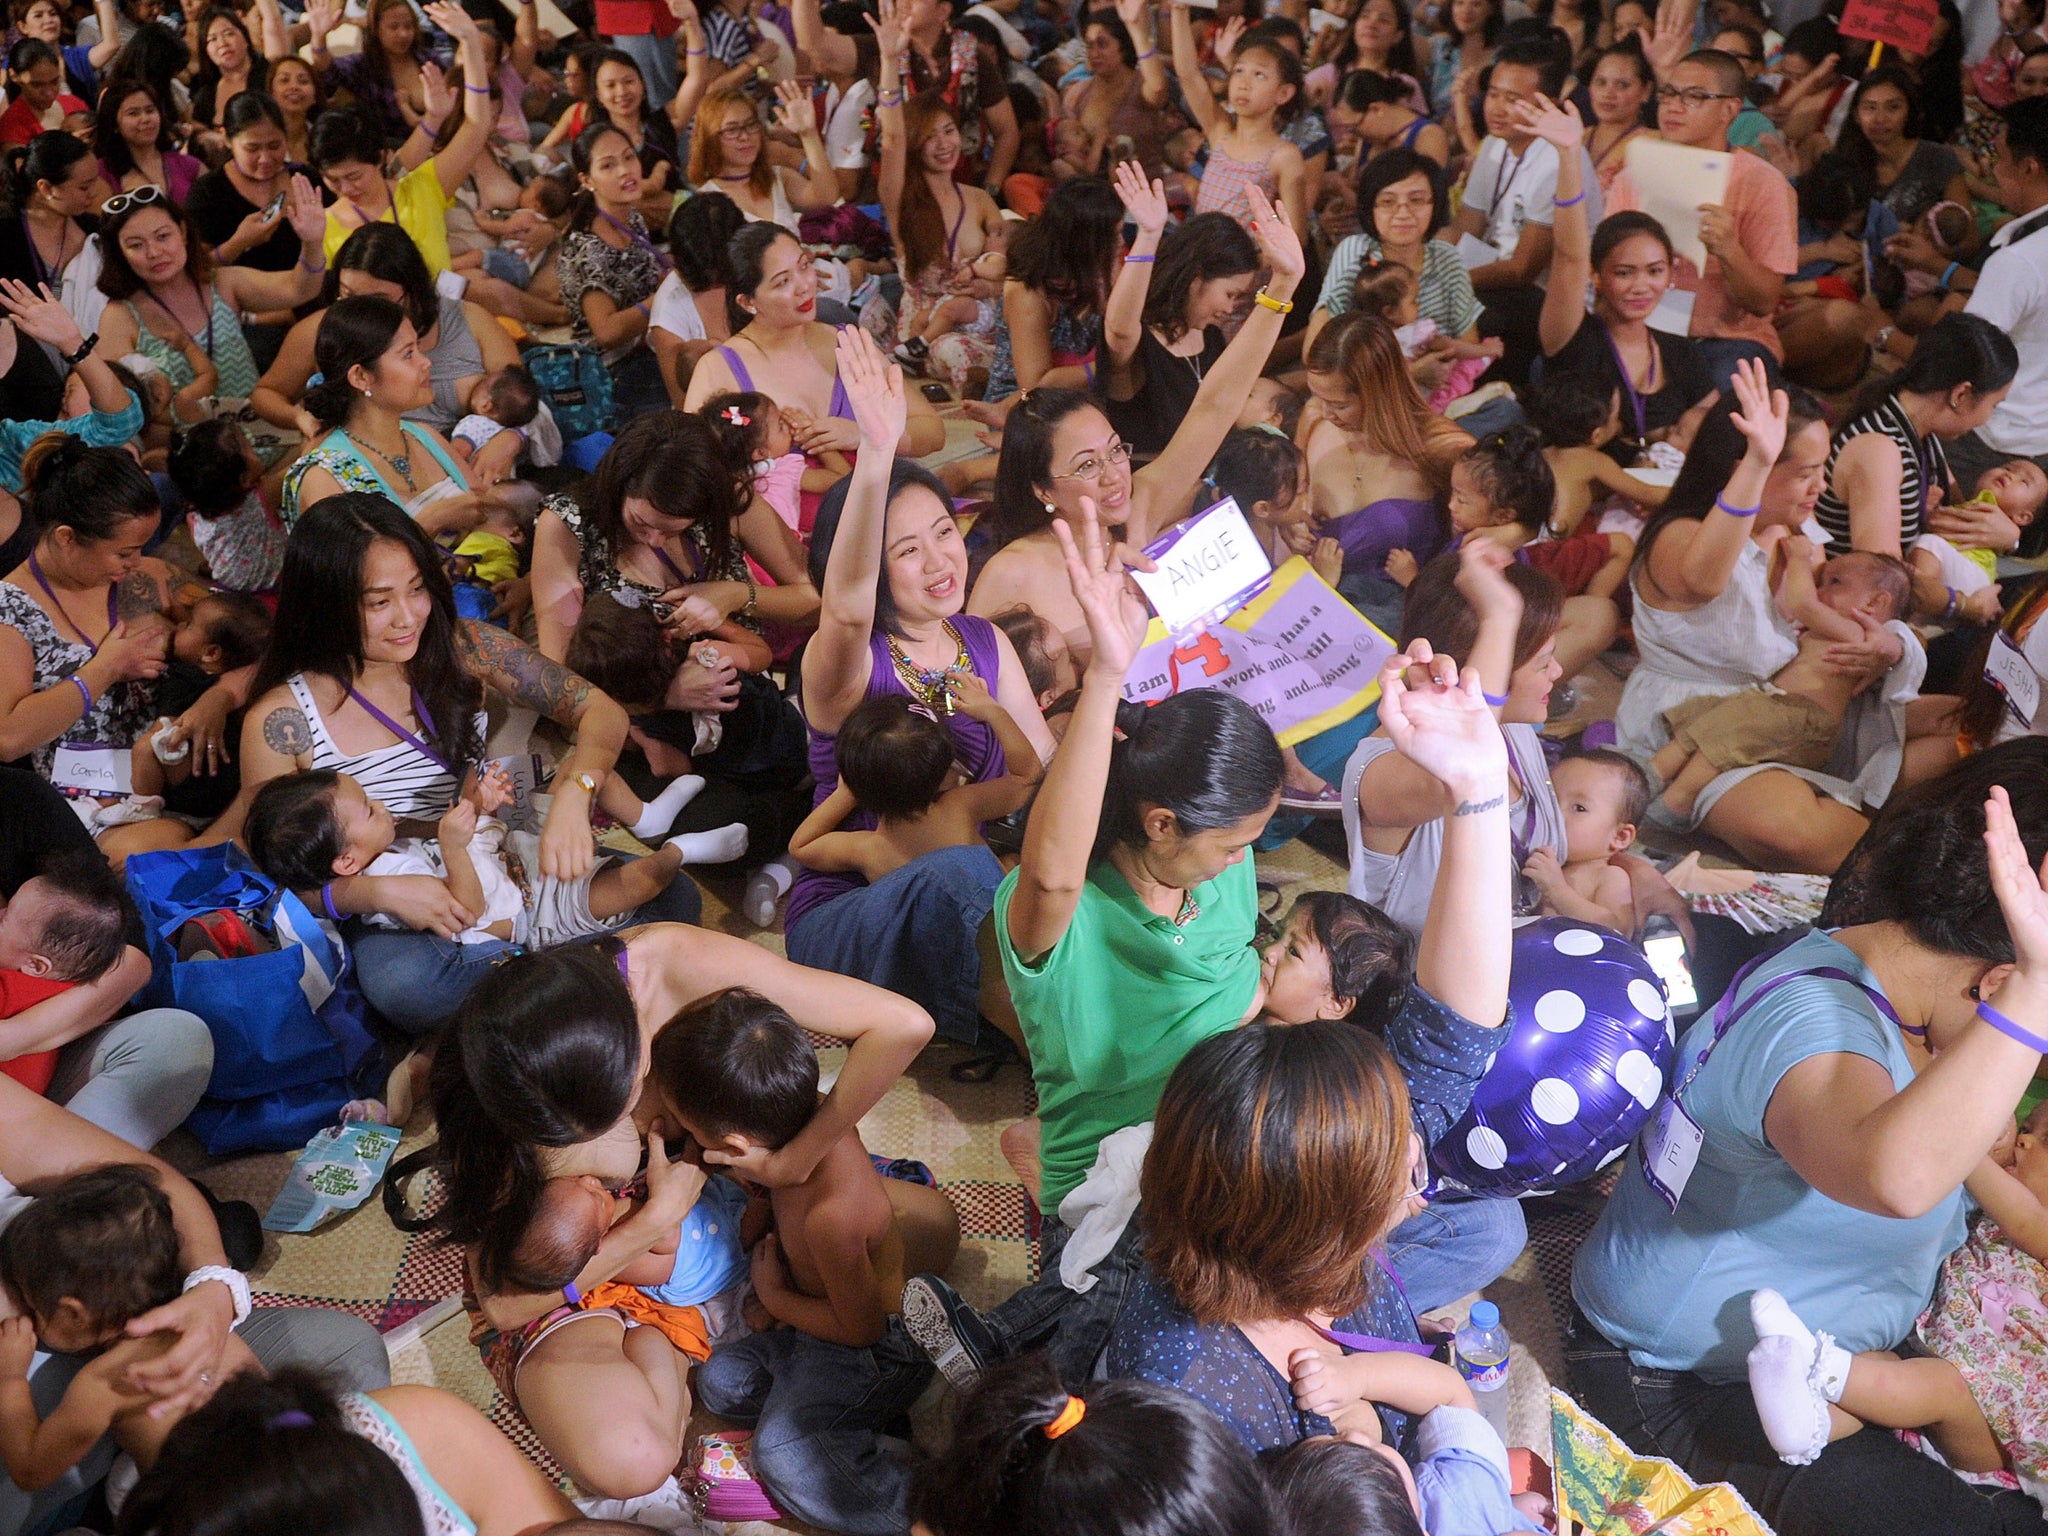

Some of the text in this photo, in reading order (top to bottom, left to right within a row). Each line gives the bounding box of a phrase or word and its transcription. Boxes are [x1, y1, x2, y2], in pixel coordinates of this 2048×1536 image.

[1167, 531, 1239, 597] ANGIE
[1280, 616, 1311, 644] has
[1310, 605, 1322, 616] a
[1138, 672, 1168, 693] am
[1221, 663, 1266, 689] work
[1267, 653, 1293, 671] and
[2000, 657, 2033, 702] JESHA
[70, 763, 114, 780] Carla
